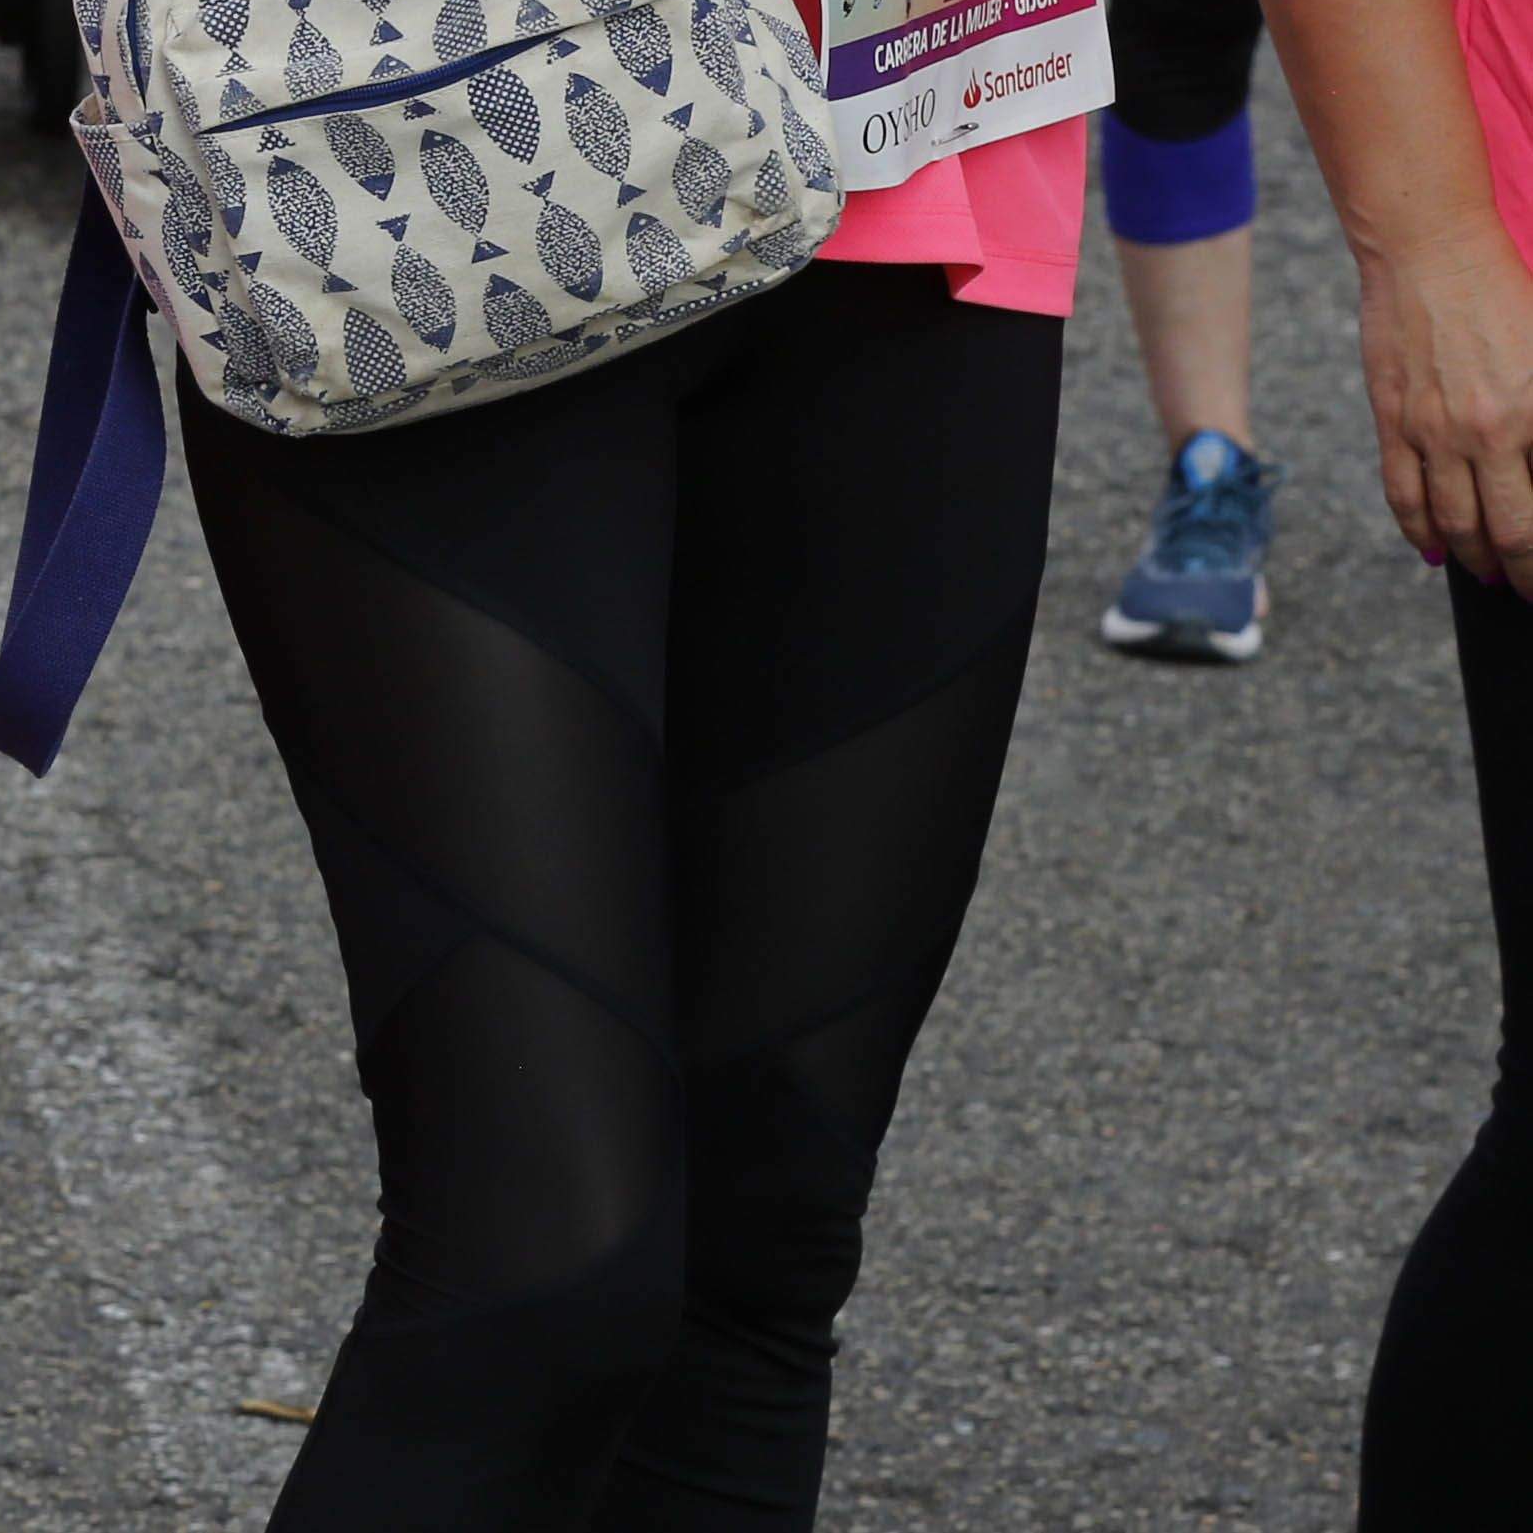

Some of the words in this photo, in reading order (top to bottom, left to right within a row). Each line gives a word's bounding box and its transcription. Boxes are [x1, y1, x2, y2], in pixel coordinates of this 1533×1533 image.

[874, 34, 928, 74] CARRERA
[931, 22, 947, 51] DE
[950, 16, 965, 44] LA
[984, 52, 1072, 102] Santander
[862, 88, 936, 155] OYSHO
